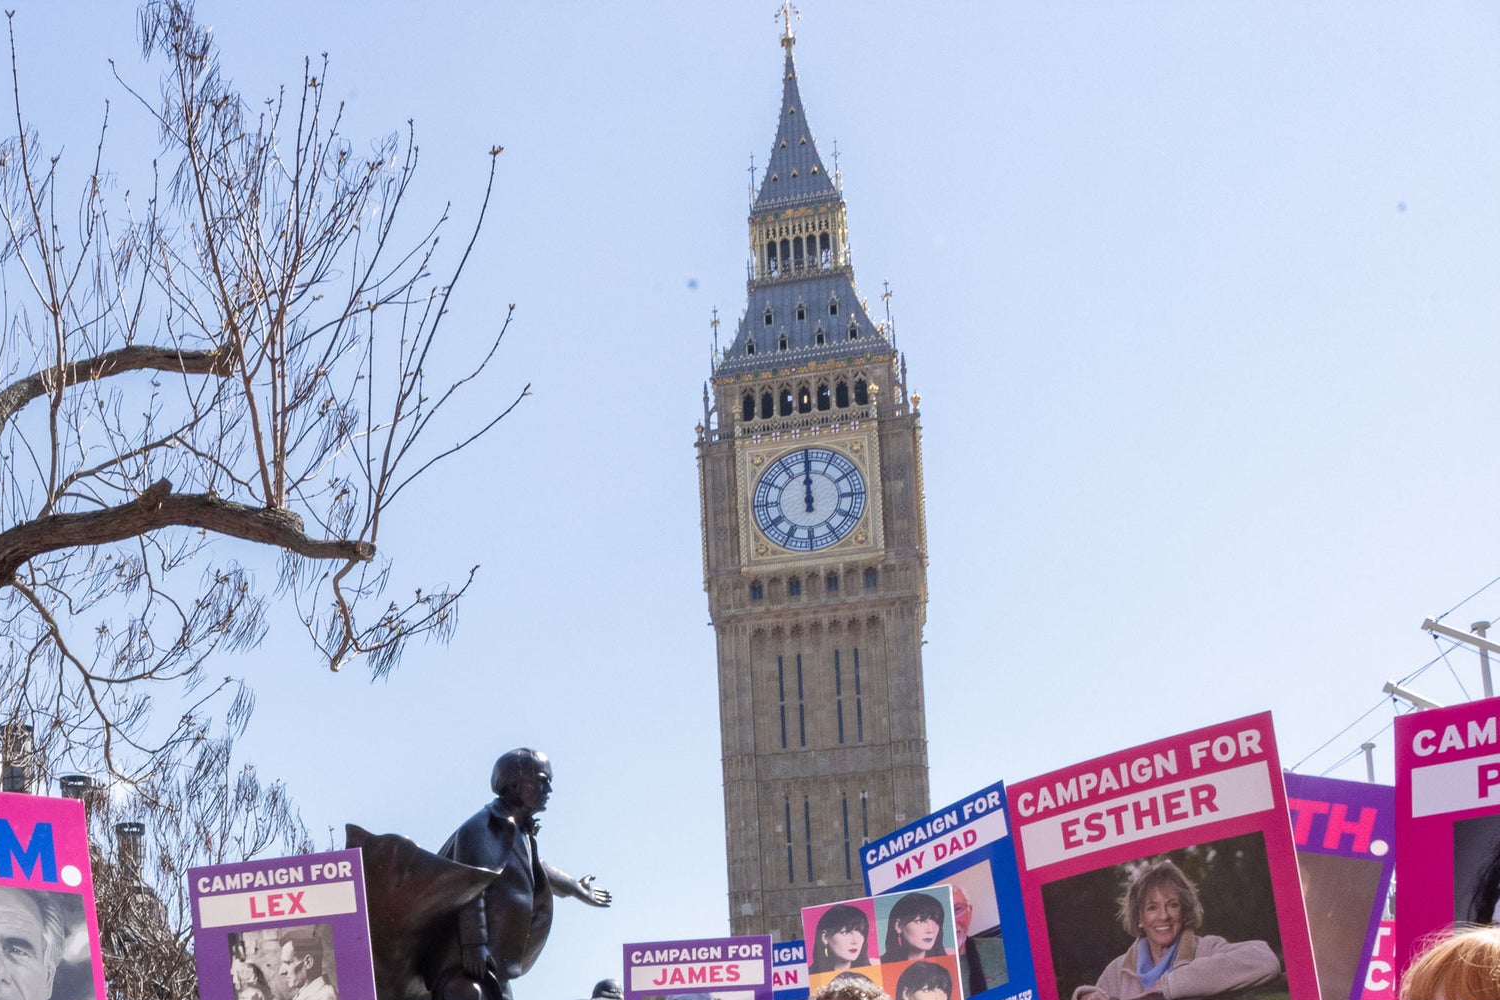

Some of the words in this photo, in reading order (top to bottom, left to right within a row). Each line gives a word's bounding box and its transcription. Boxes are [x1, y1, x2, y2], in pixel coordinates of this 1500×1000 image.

[1017, 750, 1178, 818] CAMPAIGN
[1189, 729, 1263, 769] FOR
[866, 810, 958, 865] CAMPAIGN
[963, 790, 1001, 820] FOR
[1061, 783, 1220, 851] ESTHER
[1289, 797, 1389, 857] TH.
[895, 851, 925, 879] MY
[933, 829, 978, 861] DAD
[197, 866, 304, 894] CAMPAIGN
[310, 861, 353, 881] FOR
[249, 891, 307, 919] LEX
[631, 946, 722, 964] CAMPAIGN
[727, 944, 763, 958] FOR
[652, 964, 741, 986] JAMES
[1018, 989, 1032, 999] FOR
